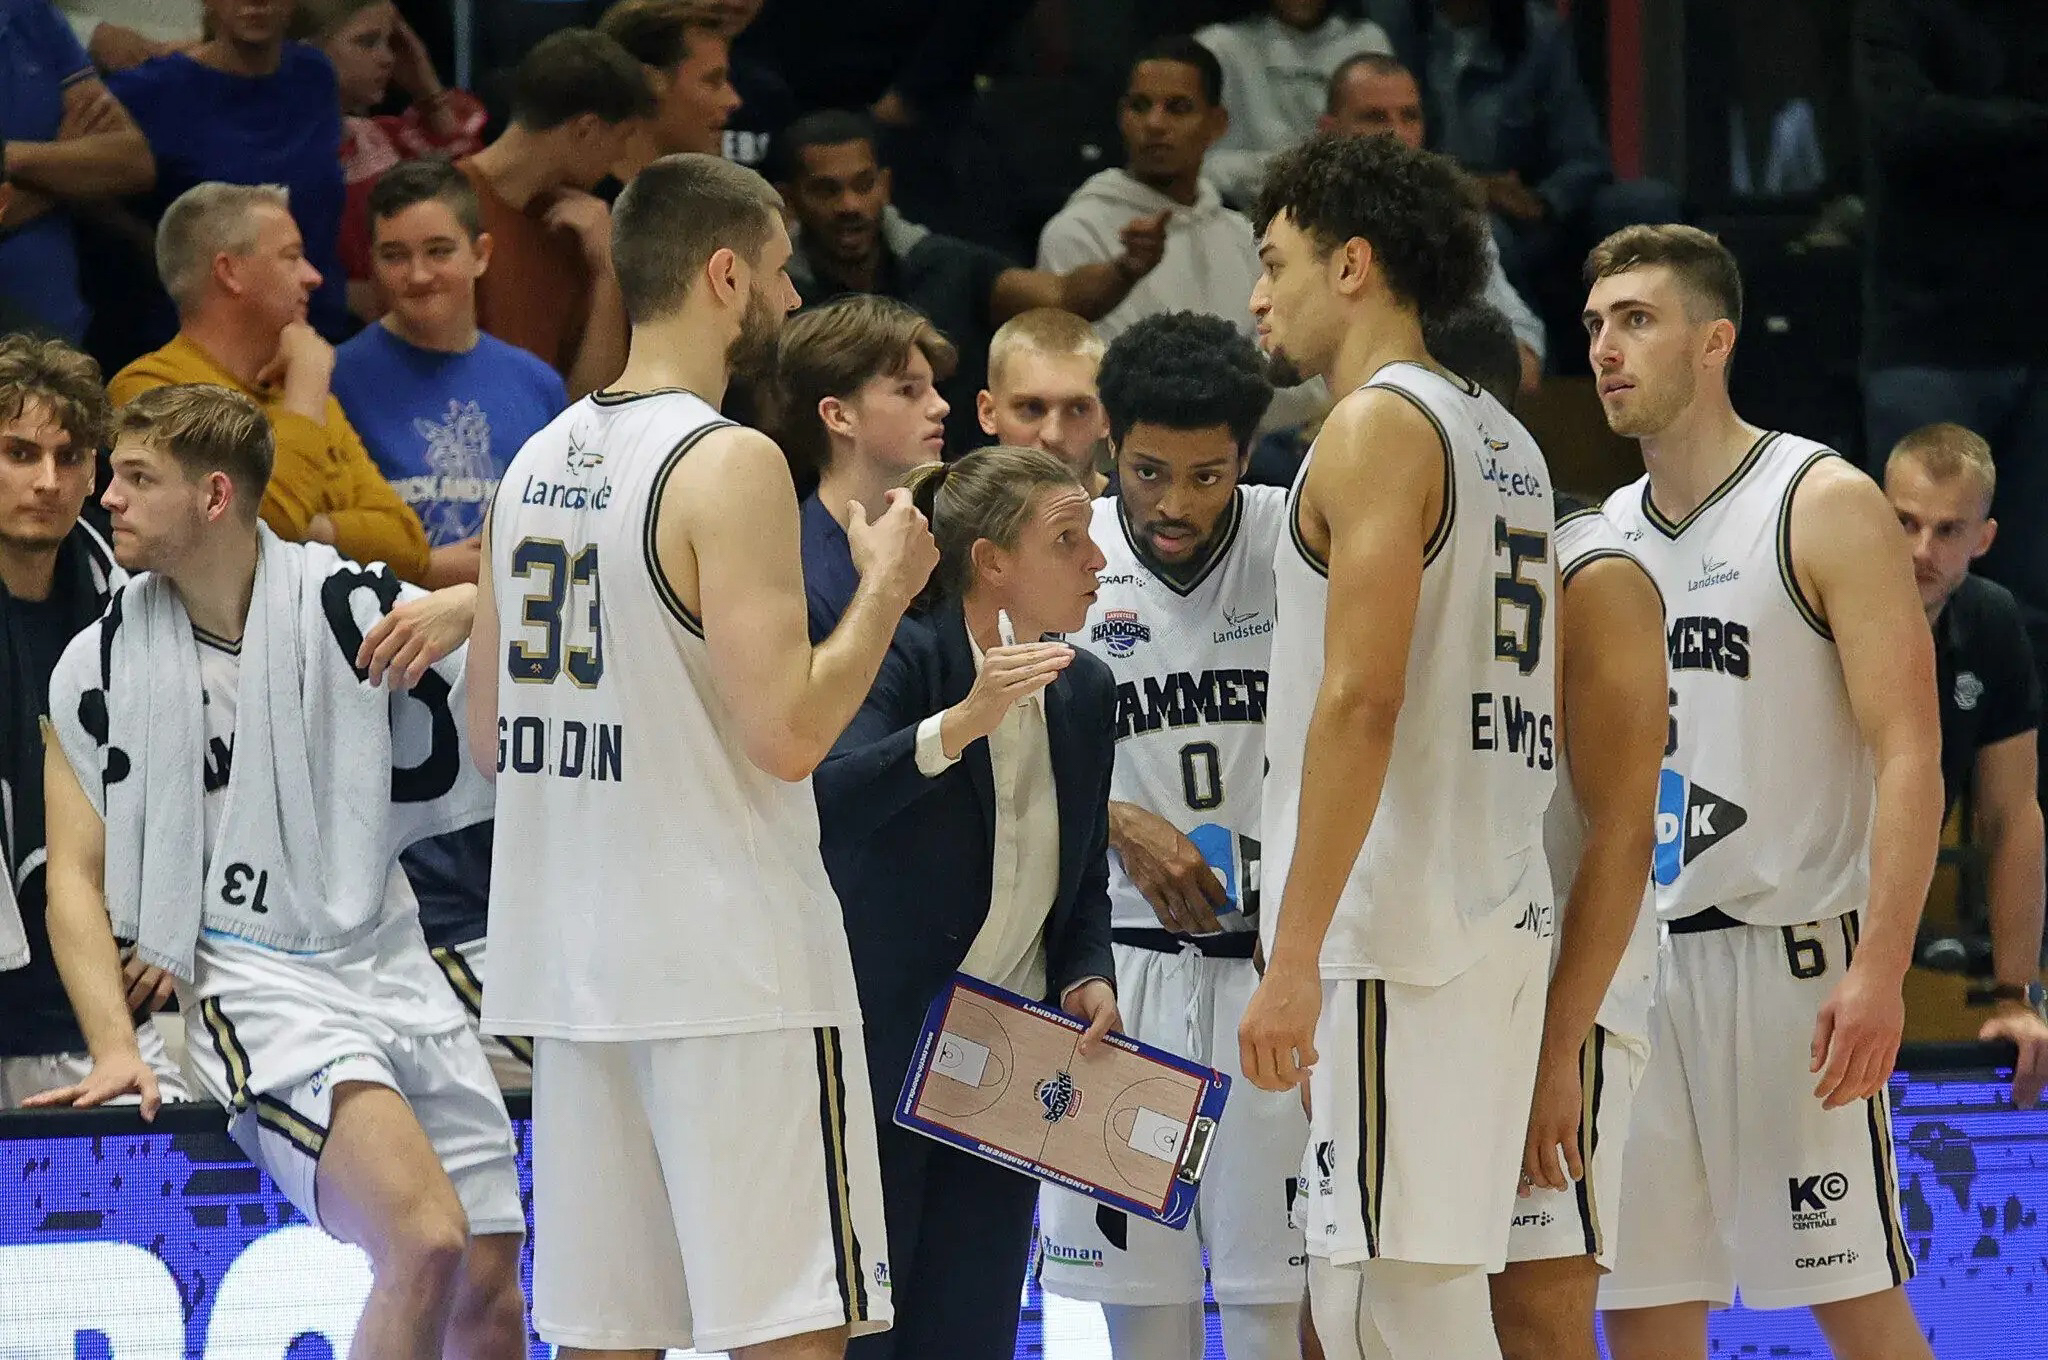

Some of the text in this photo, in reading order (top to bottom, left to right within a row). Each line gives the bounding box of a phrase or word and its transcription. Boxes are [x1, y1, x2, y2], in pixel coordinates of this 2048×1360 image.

[1688, 569, 1740, 592] Landstede
[1114, 668, 1269, 745] AMMER
[1180, 741, 1226, 812] 0
[1781, 921, 1828, 980] 6
[1023, 1003, 1084, 1031] LANDSTEDE
[977, 1142, 1096, 1194] LANDSTEDE HAMMERS
[1792, 1211, 1827, 1222] KRACHT
[1793, 1218, 1837, 1231] CENTRALE
[1795, 1253, 1846, 1269] CRAFT
